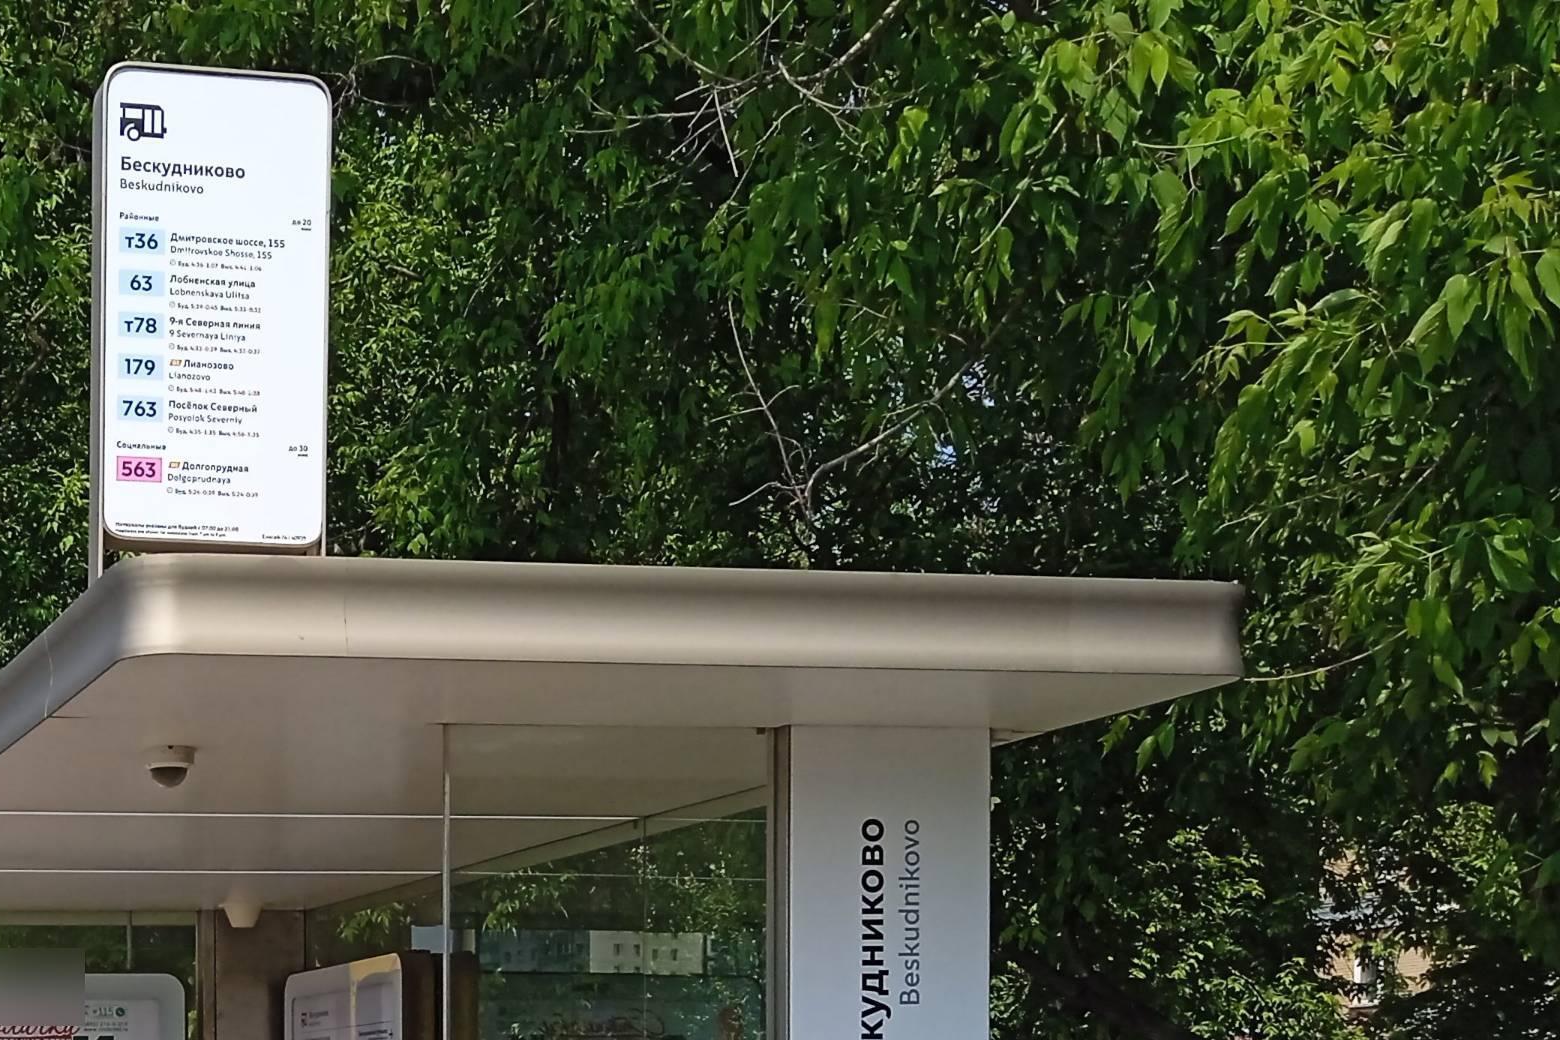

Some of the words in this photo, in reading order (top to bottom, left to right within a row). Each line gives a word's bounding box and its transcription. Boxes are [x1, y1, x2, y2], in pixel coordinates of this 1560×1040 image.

[120, 155, 246, 179] Бескудниково
[120, 178, 204, 194] Beskudnikovo
[119, 211, 159, 221] Районные
[125, 233, 158, 250] т36
[170, 233, 233, 246] Дмитровское
[236, 239, 266, 248] шоссе,
[268, 239, 285, 248] 155
[257, 250, 272, 259] 155
[130, 275, 152, 291] 63
[170, 275, 226, 286] Лобненская
[228, 279, 256, 288] улица
[124, 317, 157, 333] т78
[169, 317, 183, 327] 9-я
[186, 318, 231, 329] Северная
[233, 322, 261, 330] линия
[176, 330, 219, 341] Severnaya
[124, 358, 156, 376] 179
[183, 359, 234, 371] Лианозово
[169, 372, 211, 382] Lianozovo
[122, 400, 157, 417] 763
[169, 400, 209, 411] Посёлок
[210, 402, 258, 413] Северный
[122, 461, 156, 479] 563
[182, 462, 249, 474] Долгопрудная
[898, 819, 920, 1006] Beskudnikovo
